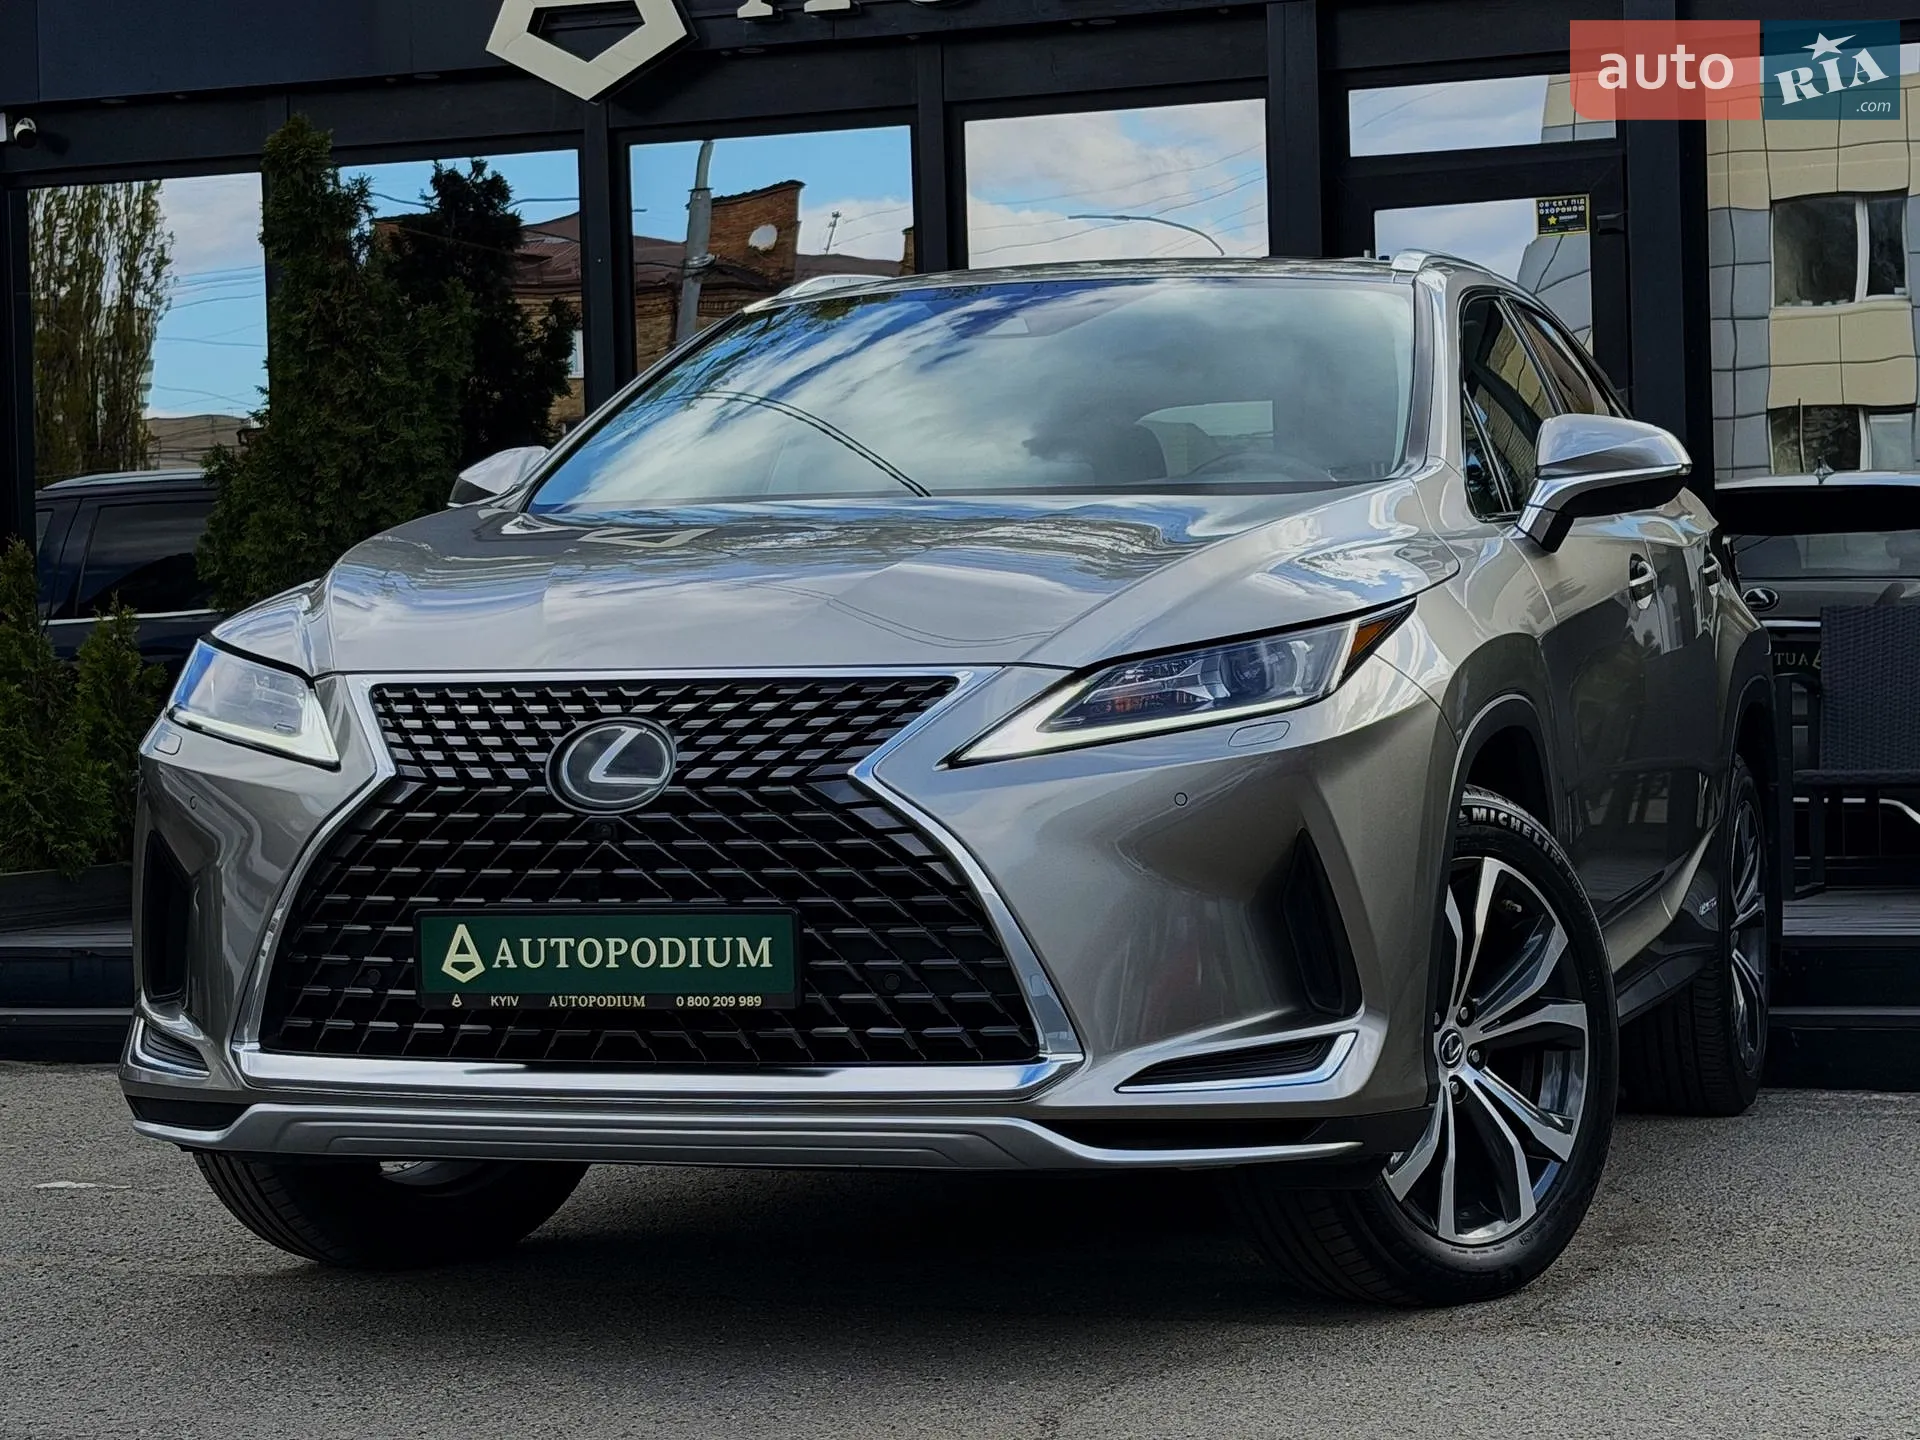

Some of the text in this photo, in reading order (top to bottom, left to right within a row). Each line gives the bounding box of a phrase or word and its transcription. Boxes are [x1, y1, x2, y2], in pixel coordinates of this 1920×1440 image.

[1471, 807, 1562, 866] MICHELIN
[492, 937, 773, 968] AUTOPODIUM
[490, 995, 762, 1008] KYIV AUTOPODIUM 0 800 209 989
